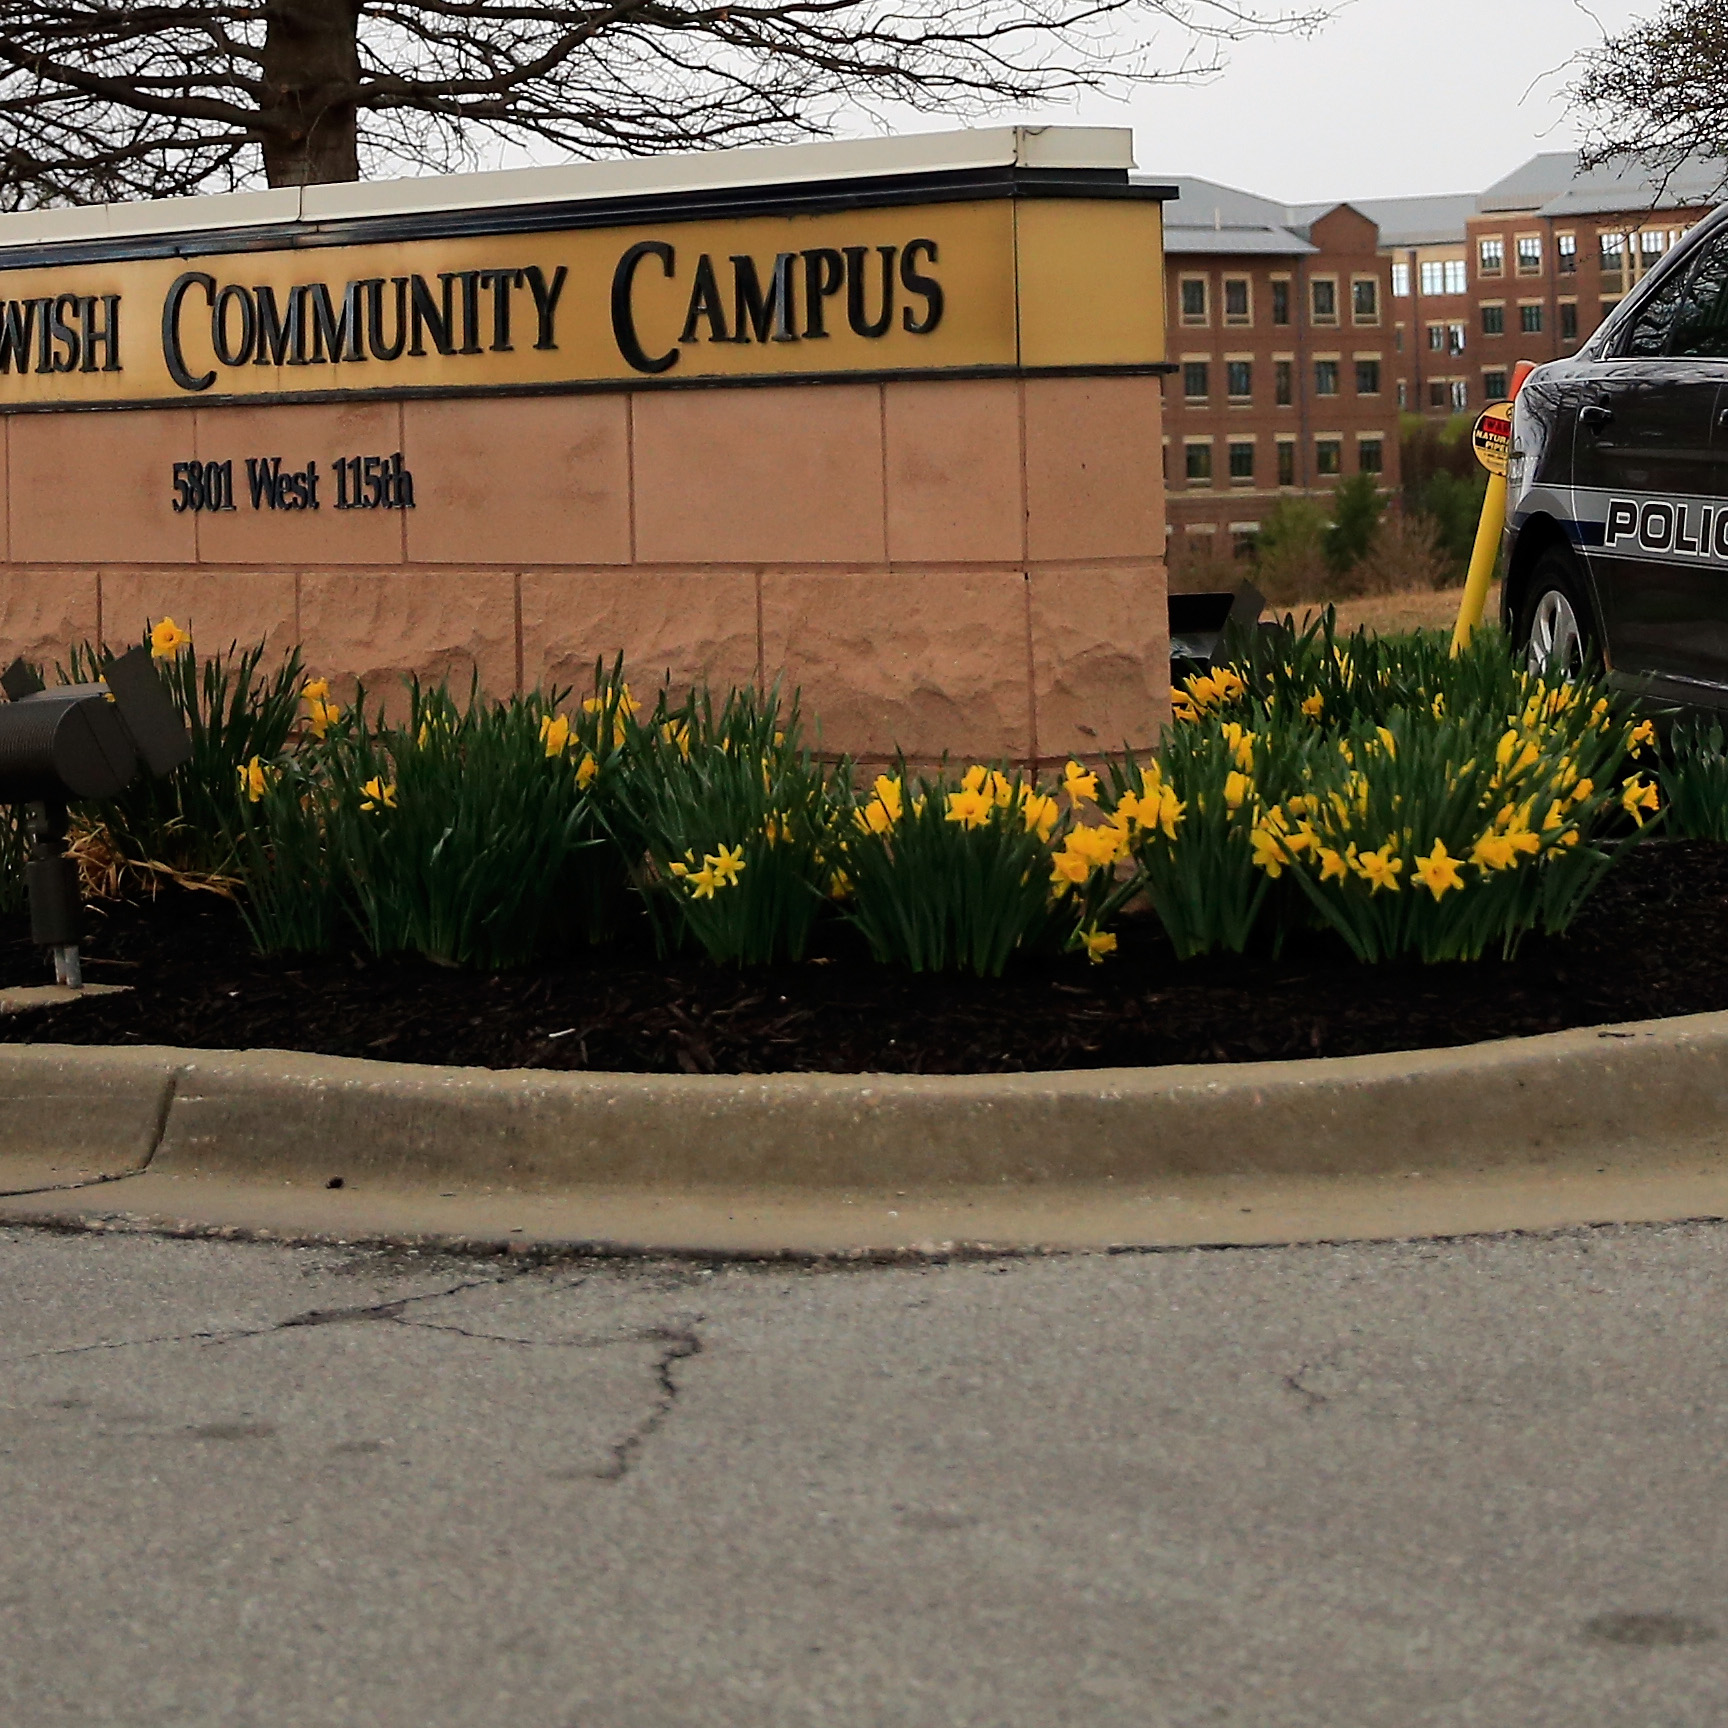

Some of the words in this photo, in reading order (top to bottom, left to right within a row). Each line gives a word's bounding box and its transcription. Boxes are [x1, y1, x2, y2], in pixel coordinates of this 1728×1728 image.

[161, 264, 568, 392] COMMUNITY
[610, 237, 943, 374] CAMPUS
[171, 459, 237, 513] 5801
[245, 457, 320, 511] West
[331, 451, 416, 510] 115th
